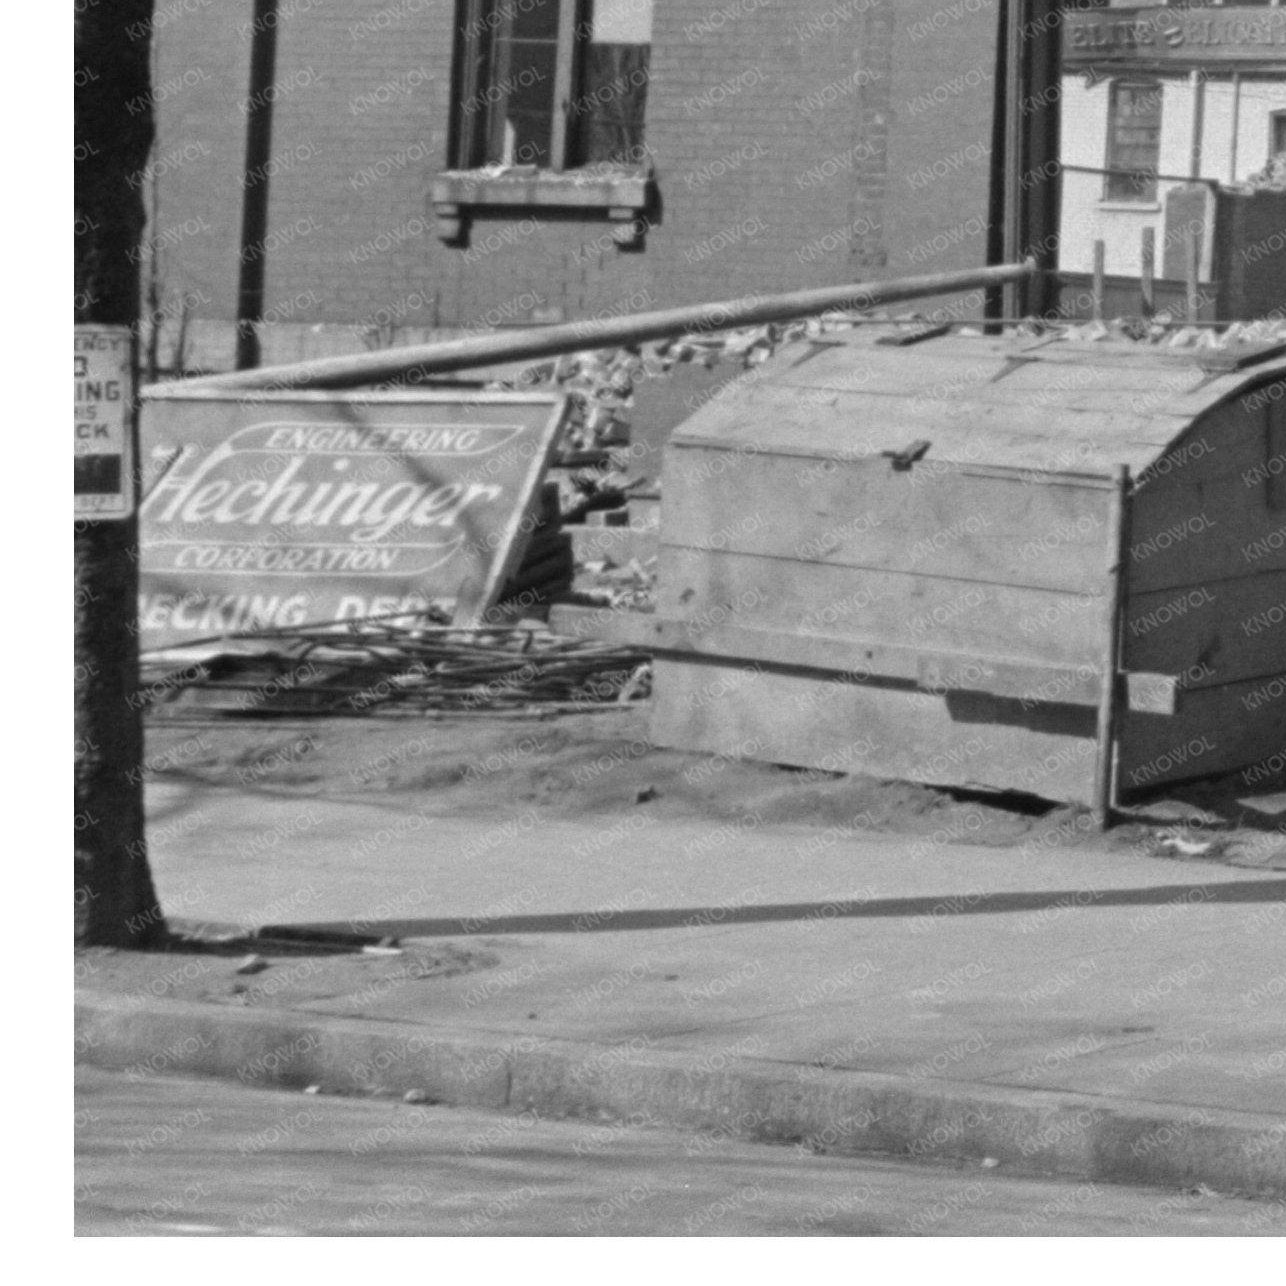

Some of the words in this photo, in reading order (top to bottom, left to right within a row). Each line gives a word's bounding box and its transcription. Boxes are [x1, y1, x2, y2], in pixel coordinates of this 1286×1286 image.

[267, 428, 479, 452] ENGINEERING
[139, 443, 501, 542] Hechinger
[175, 545, 400, 571] CORPORATION
